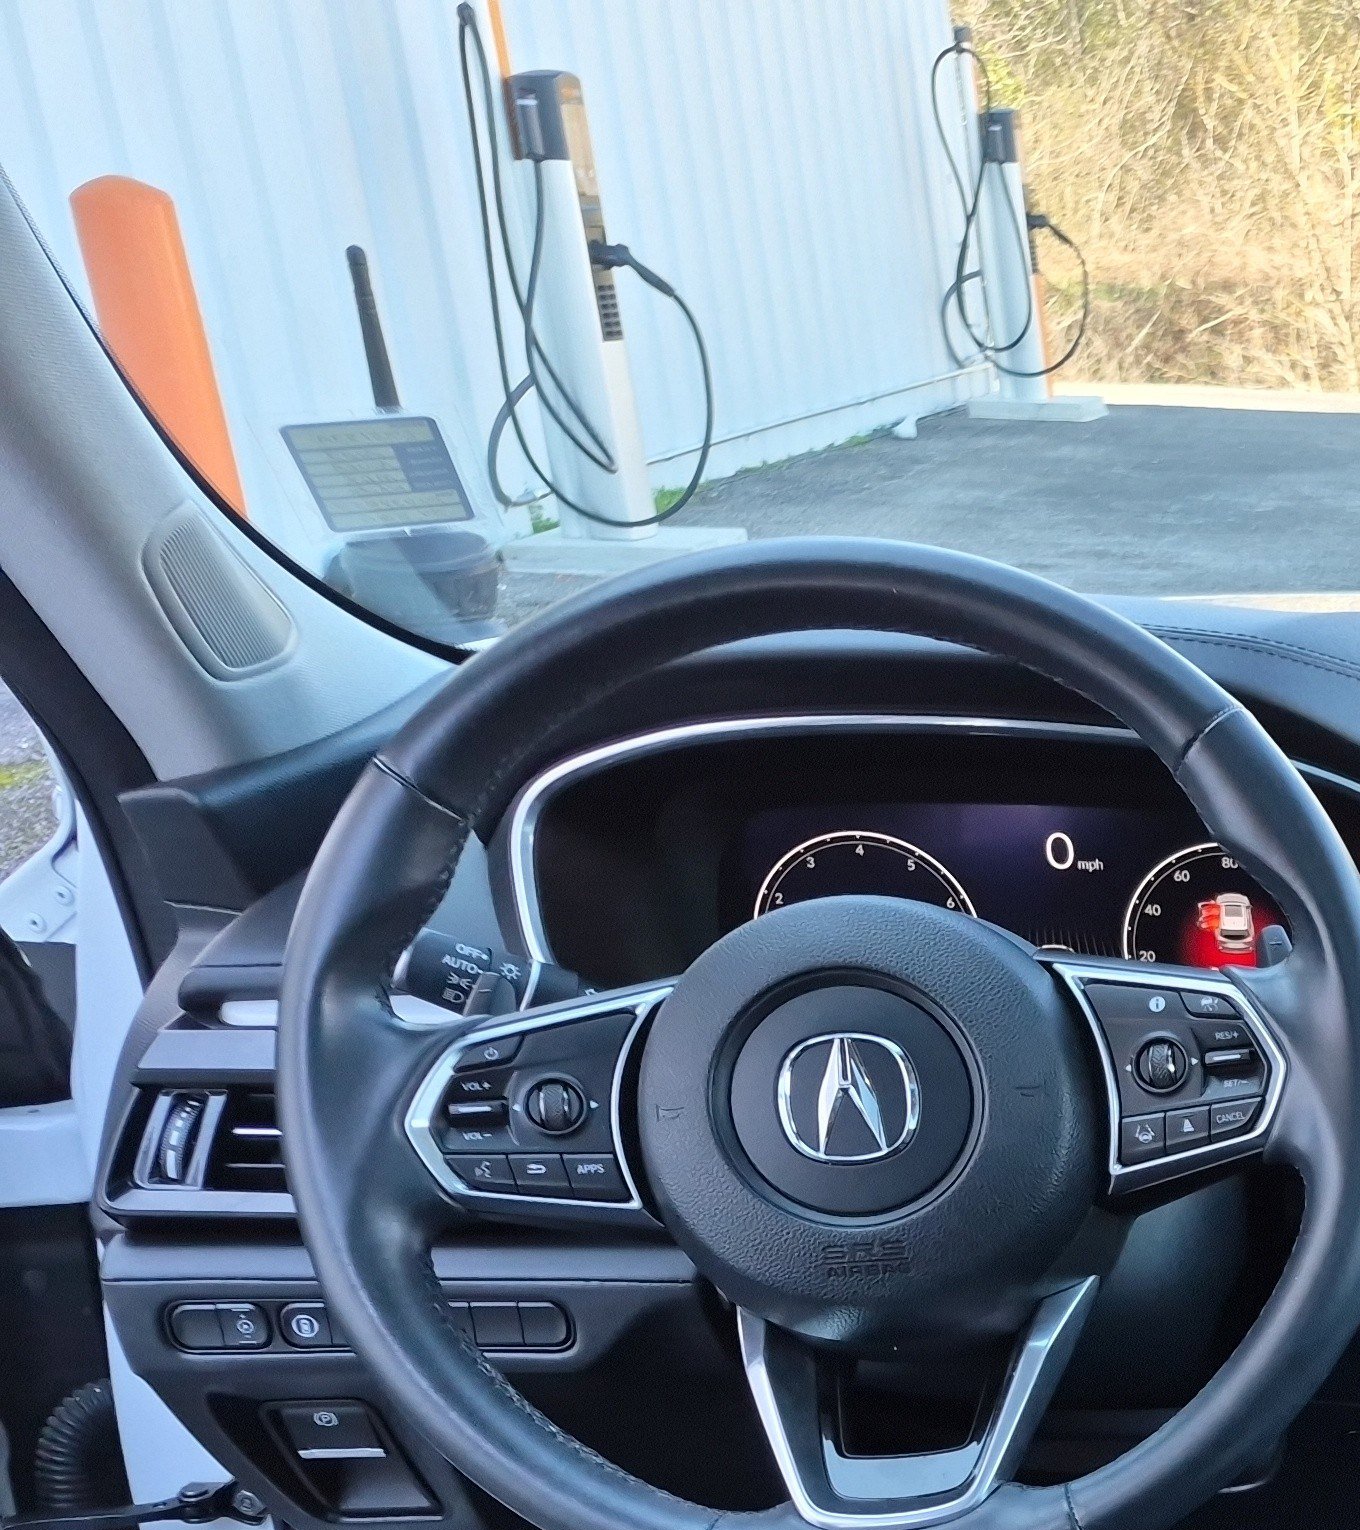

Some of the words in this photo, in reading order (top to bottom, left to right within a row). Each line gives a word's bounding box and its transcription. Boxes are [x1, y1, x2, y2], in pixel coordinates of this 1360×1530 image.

[855, 844, 865, 856] 4
[1045, 831, 1075, 870] 0
[1077, 858, 1104, 872] mph
[806, 856, 816, 869] 3
[906, 859, 916, 871] 5
[1173, 870, 1191, 882] 60
[774, 892, 784, 905] 2
[946, 896, 956, 908] 6
[1144, 904, 1162, 917] 40
[1139, 950, 1156, 963] 20
[576, 1163, 605, 1175] APPS
